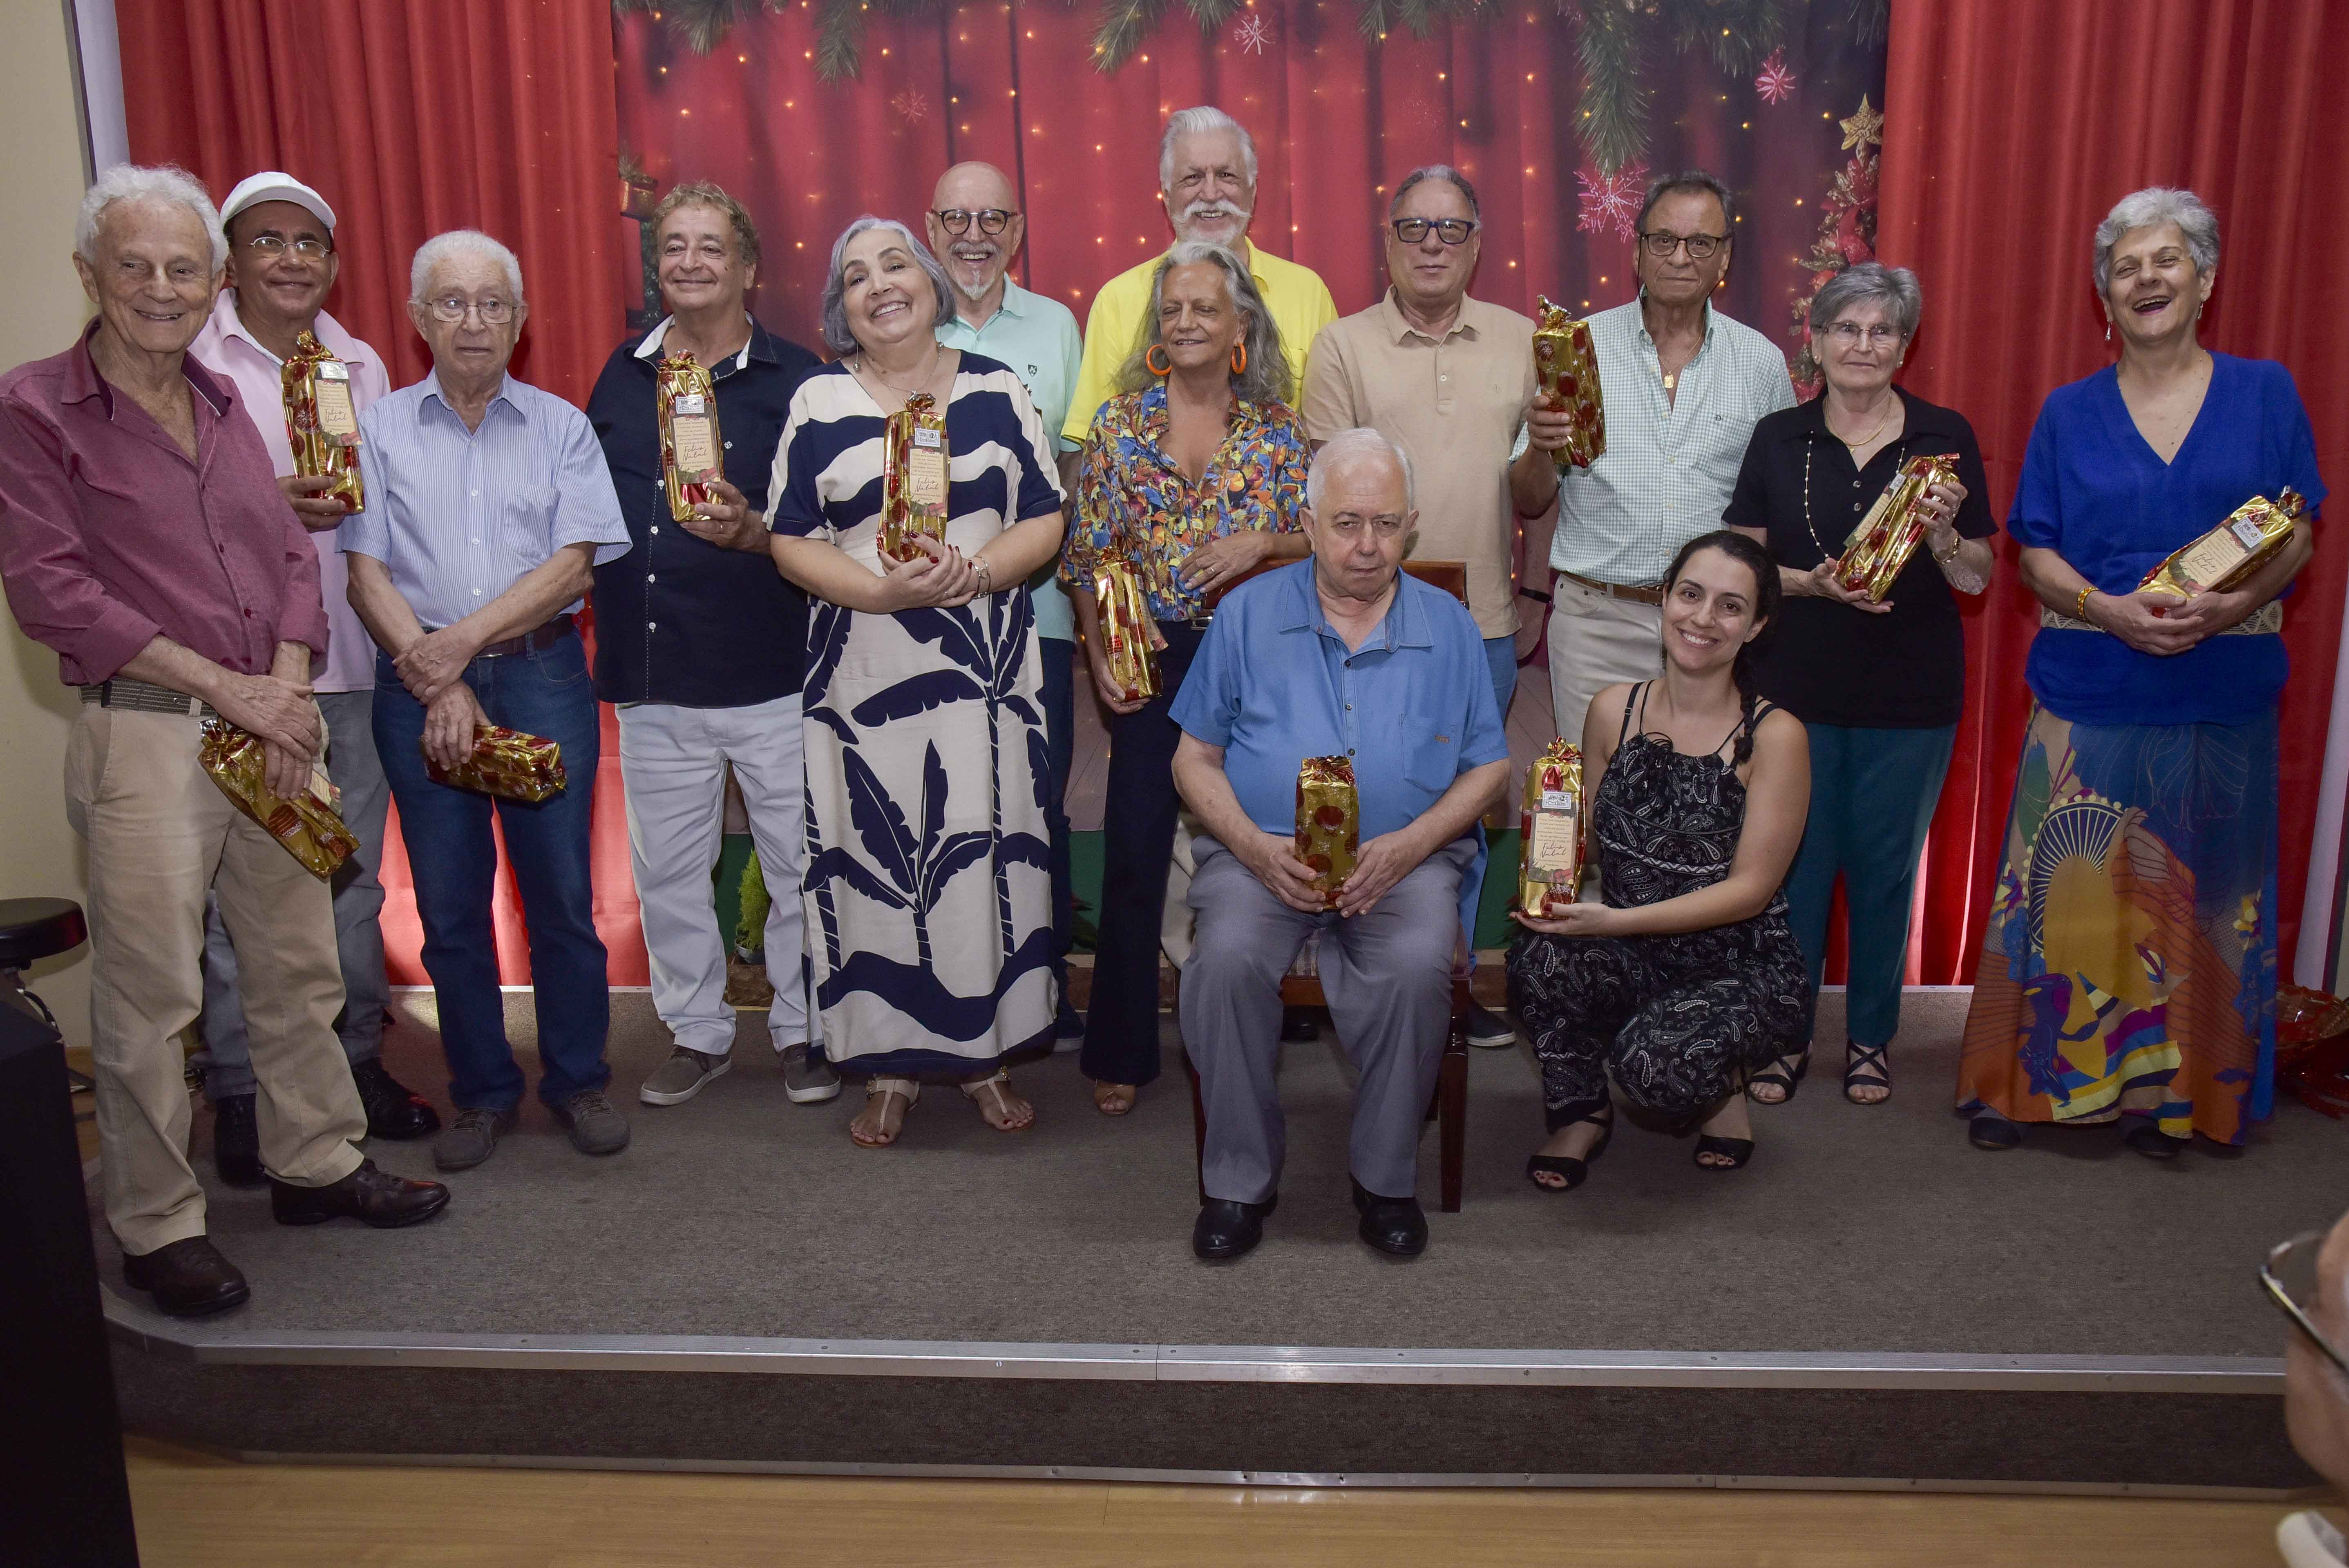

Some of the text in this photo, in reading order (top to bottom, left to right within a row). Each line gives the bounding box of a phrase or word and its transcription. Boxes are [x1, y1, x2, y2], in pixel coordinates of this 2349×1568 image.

[326, 413, 347, 423] Natal
[684, 444, 706, 453] Feliz
[683, 451, 708, 462] Natal
[917, 477, 938, 485] Feliz
[915, 483, 939, 493] Natal
[1542, 842, 1565, 851] Feliz
[1540, 849, 1566, 859] Natal
